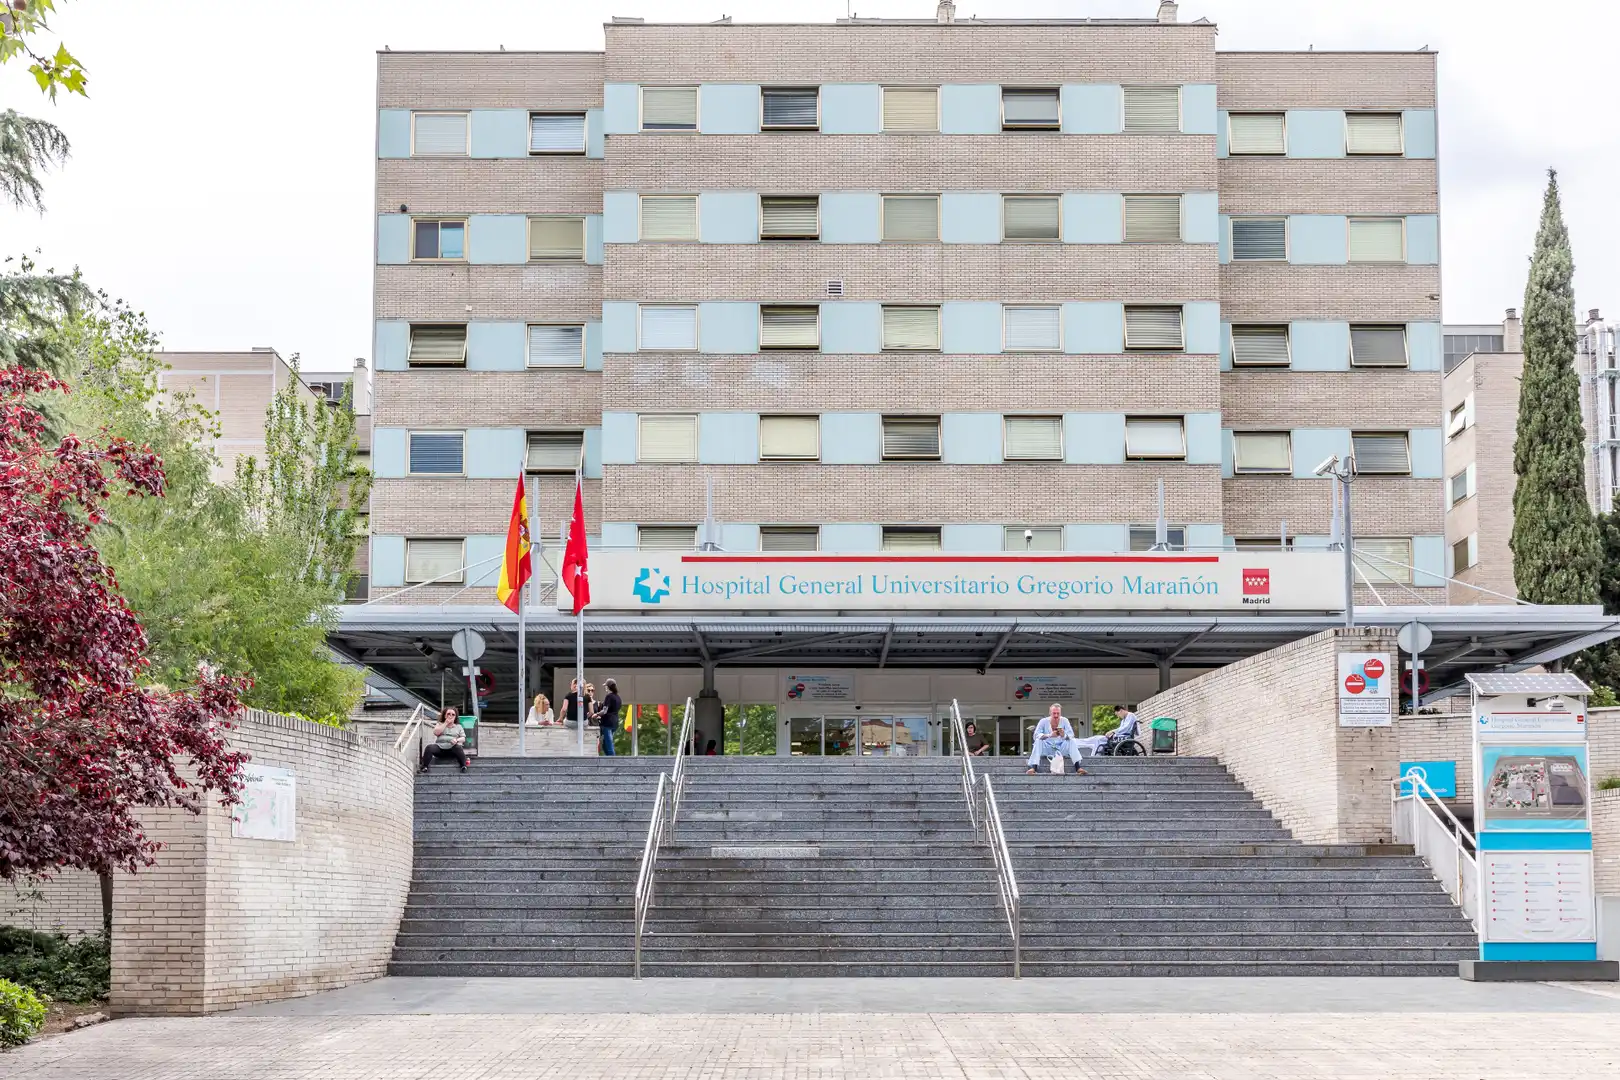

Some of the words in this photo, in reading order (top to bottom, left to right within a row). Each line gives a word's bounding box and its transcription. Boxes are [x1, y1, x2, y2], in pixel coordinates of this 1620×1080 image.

[681, 575, 770, 600] Hospital
[778, 575, 863, 595] General
[871, 575, 1009, 595] Universitario
[1016, 575, 1113, 600] Gregorio
[1122, 575, 1219, 595] Marañón
